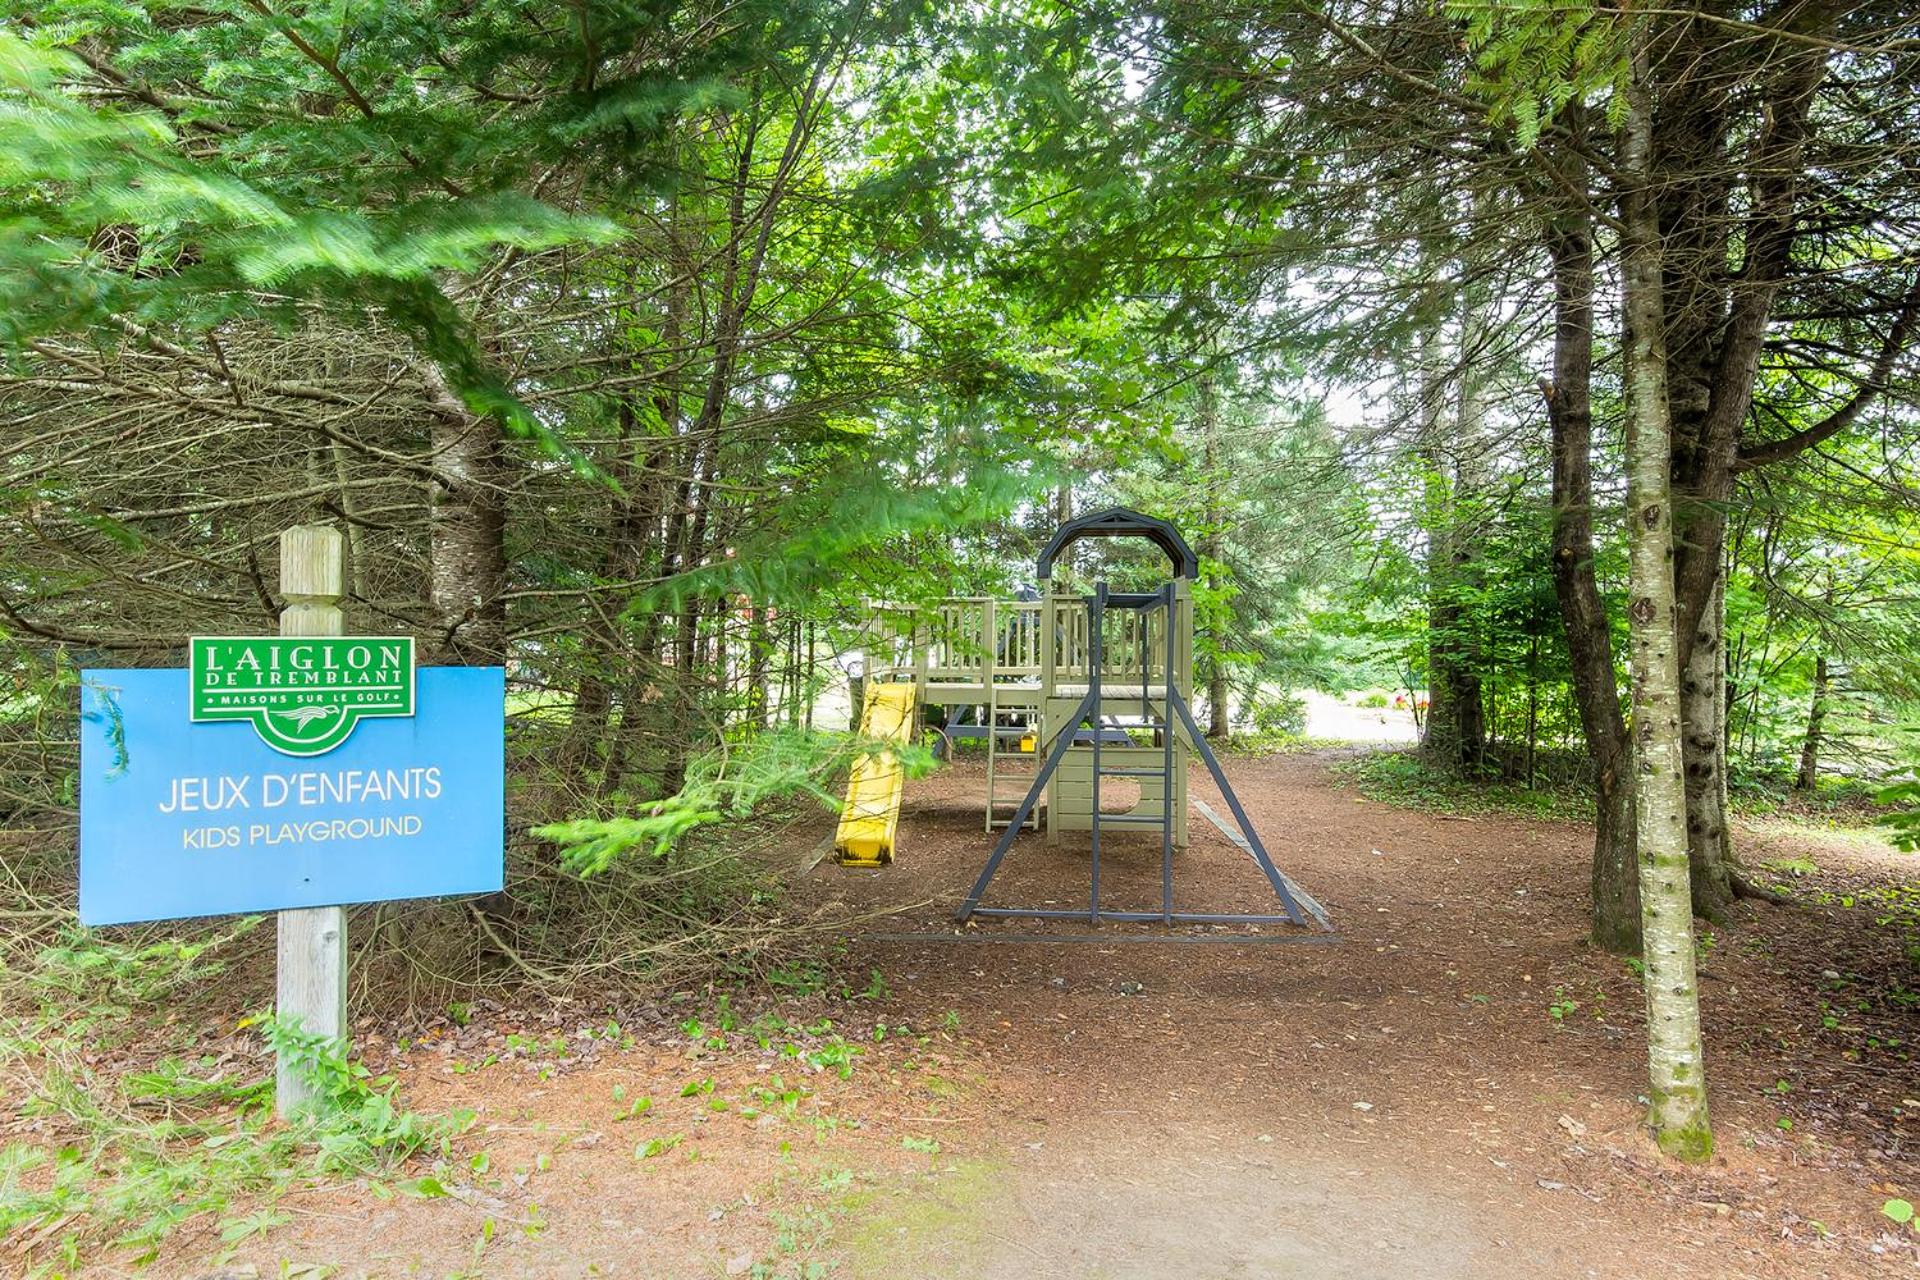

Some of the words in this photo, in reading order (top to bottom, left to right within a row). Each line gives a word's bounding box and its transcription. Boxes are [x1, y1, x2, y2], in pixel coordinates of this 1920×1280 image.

[205, 645, 402, 671] L'AIGLON
[205, 673, 238, 686] DE
[254, 670, 402, 686] TREMBLANT
[220, 694, 287, 705] MAISONS
[297, 694, 324, 704] SUR
[334, 694, 349, 703] LE
[357, 693, 390, 703] GOLF
[159, 775, 250, 813] JEUX
[263, 767, 441, 808] D'ENFANTS
[183, 825, 241, 849] KIDS
[249, 815, 422, 846] PLAYGROUND
